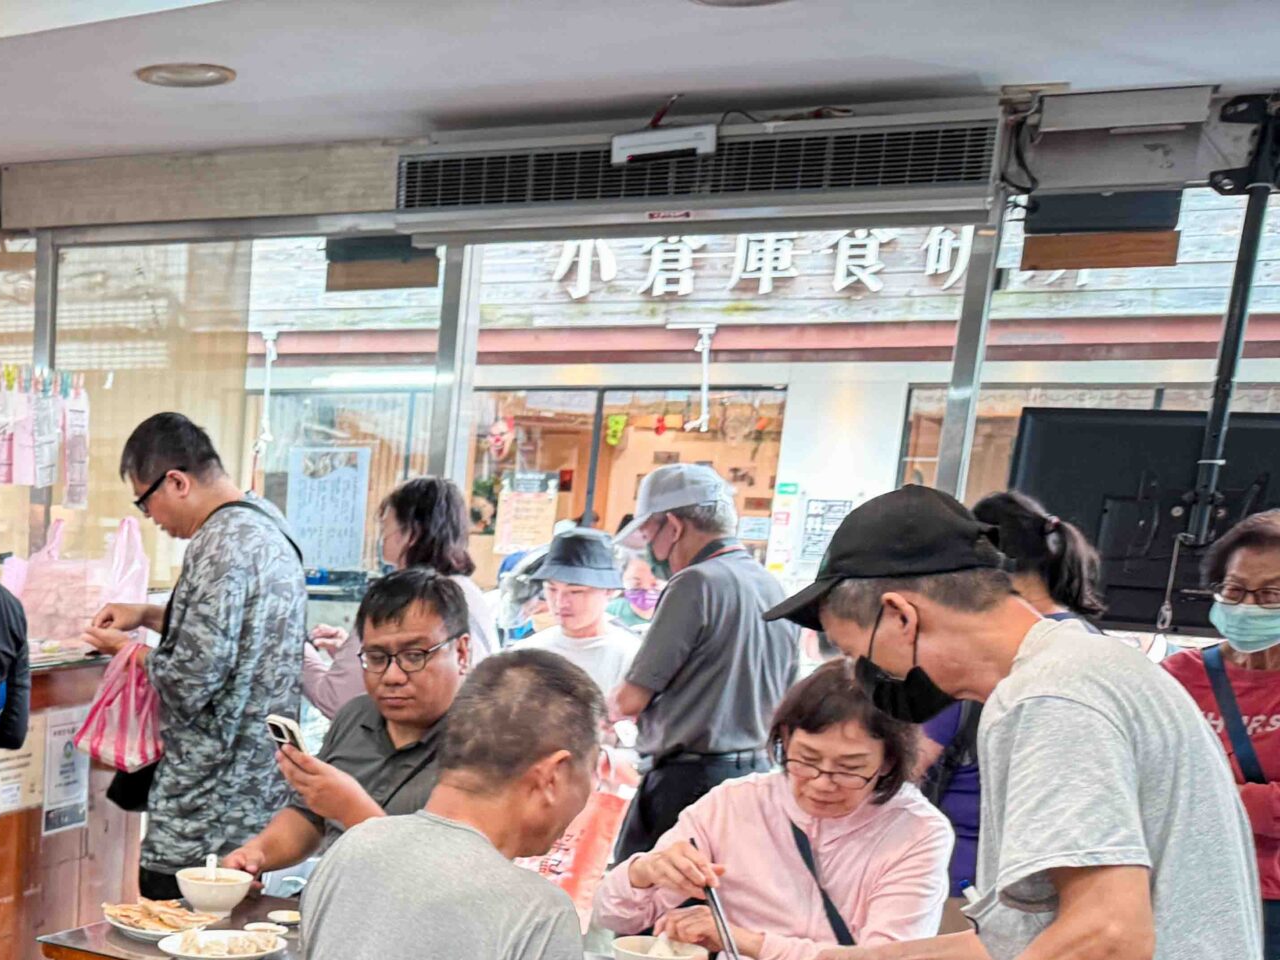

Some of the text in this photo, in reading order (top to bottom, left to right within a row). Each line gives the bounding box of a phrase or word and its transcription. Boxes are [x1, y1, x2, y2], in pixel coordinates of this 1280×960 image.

[552, 226, 1090, 300] 小倉庫食研
